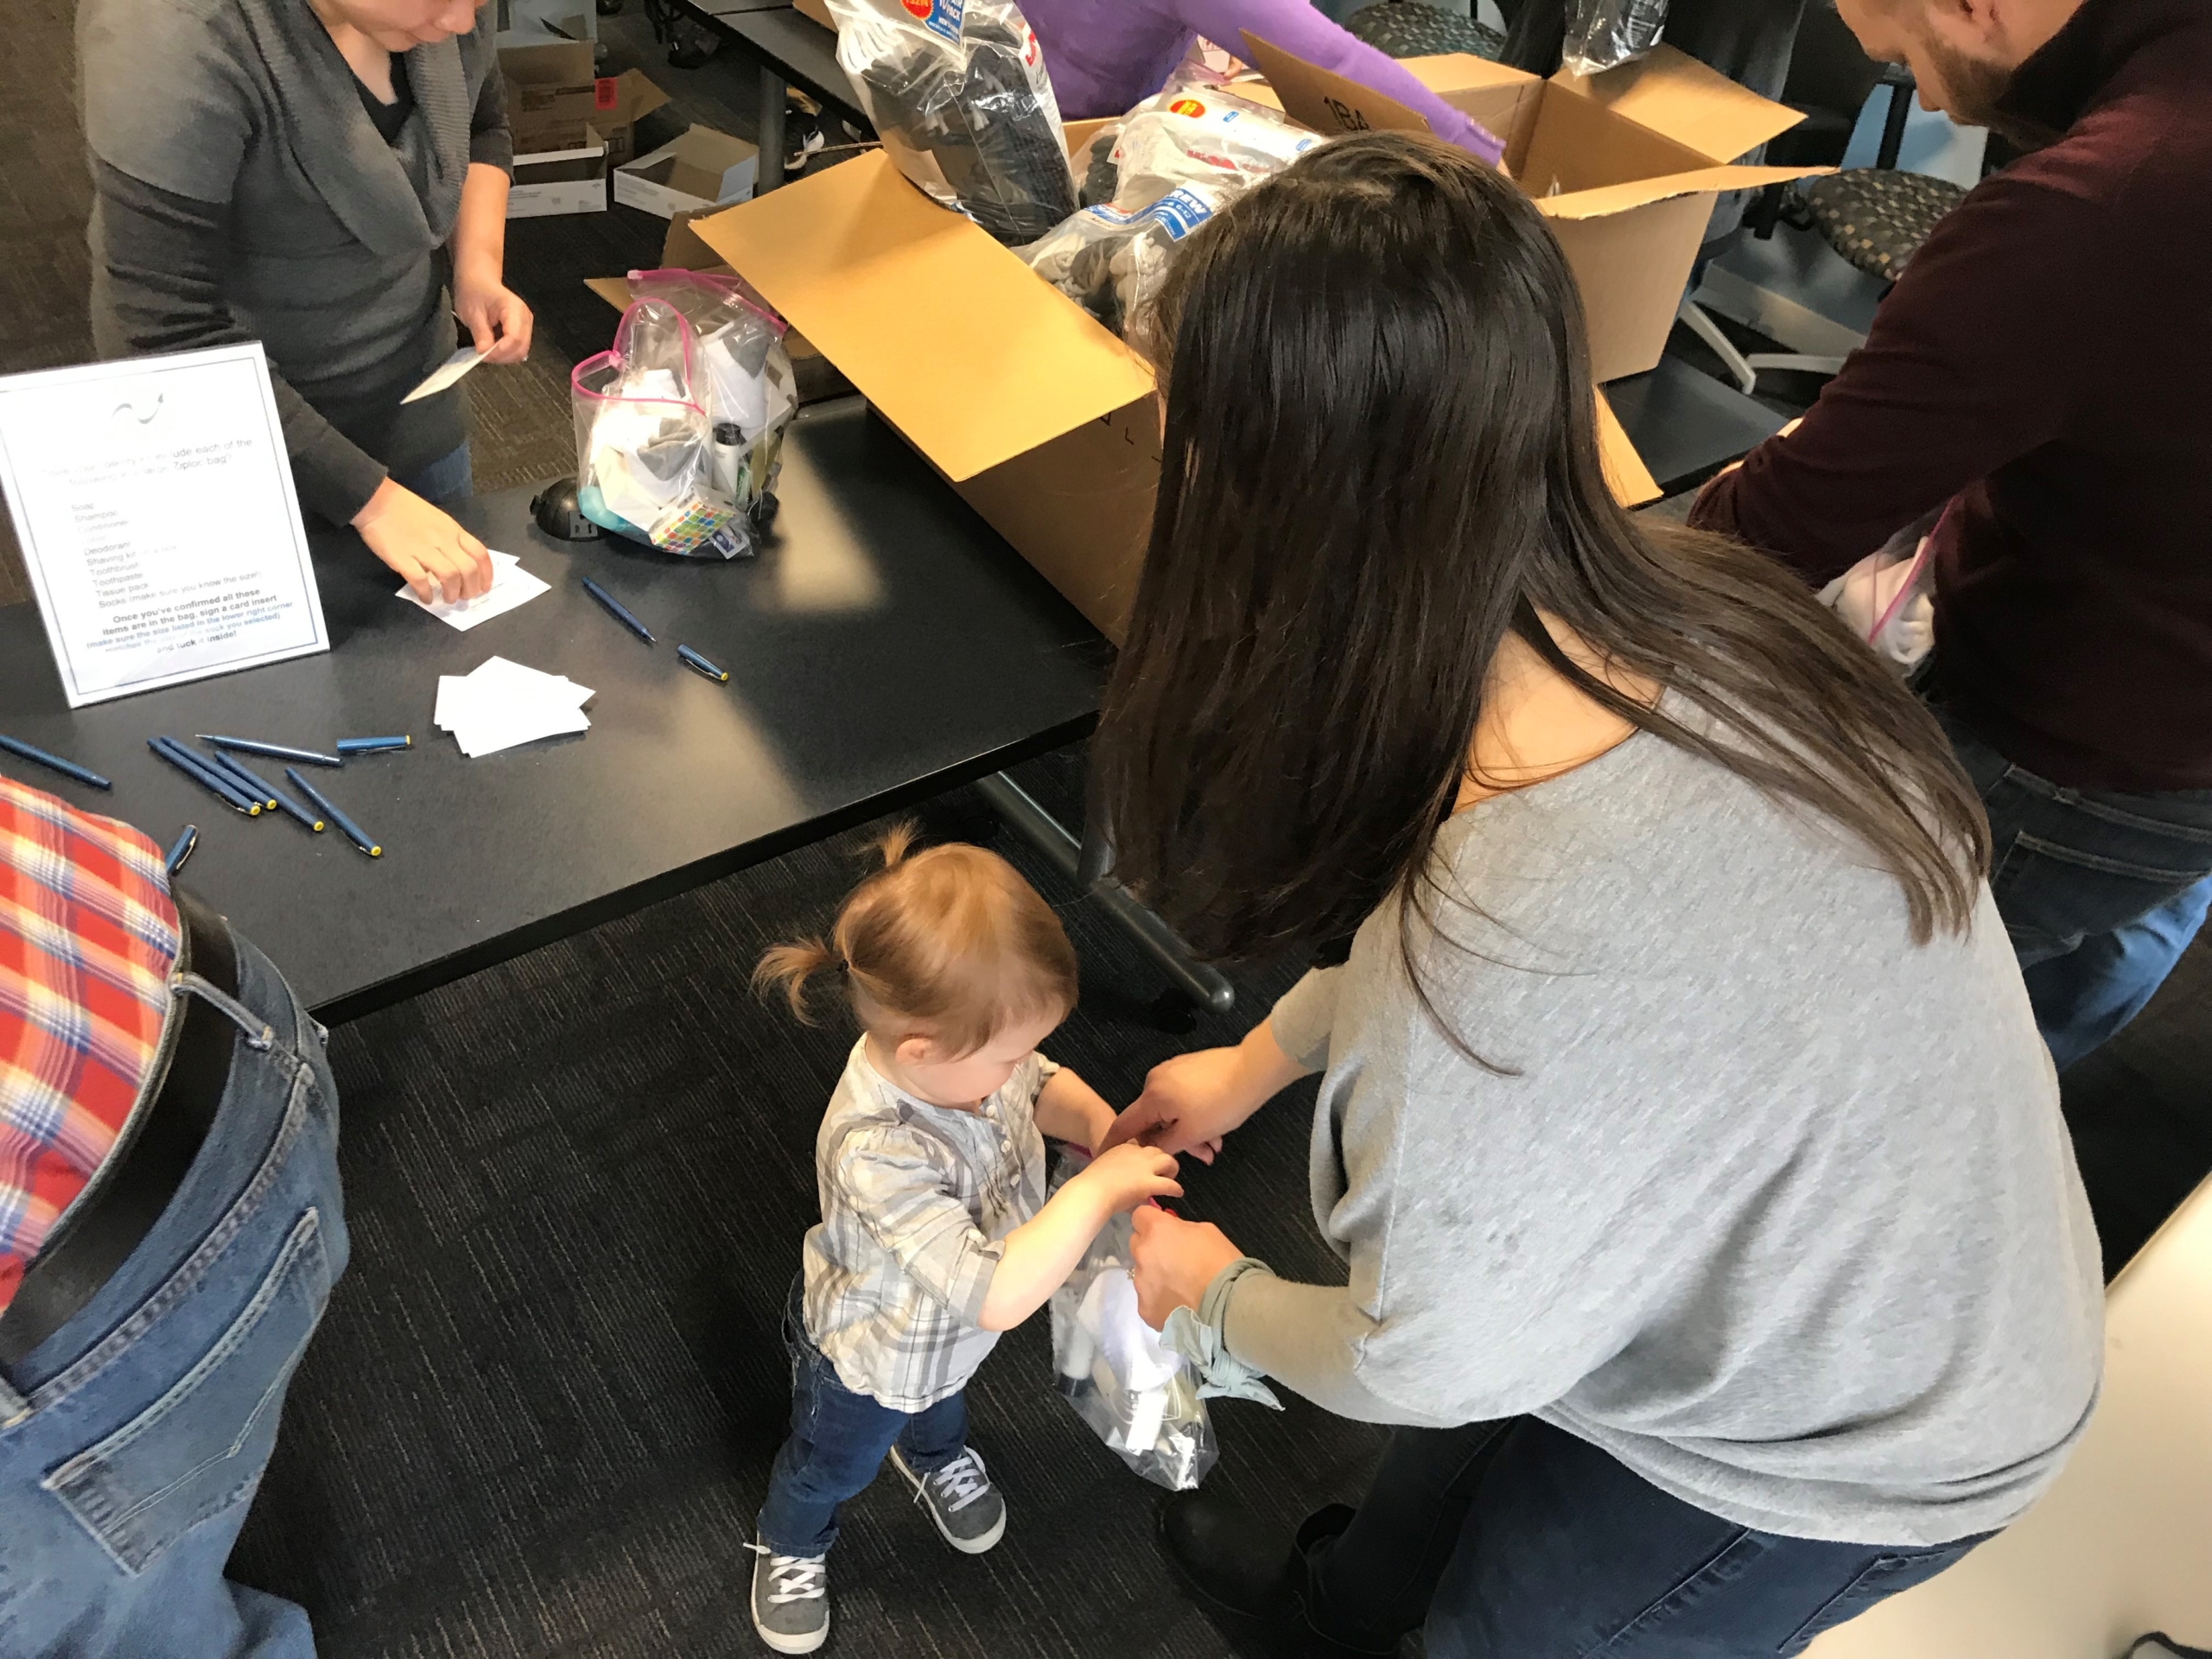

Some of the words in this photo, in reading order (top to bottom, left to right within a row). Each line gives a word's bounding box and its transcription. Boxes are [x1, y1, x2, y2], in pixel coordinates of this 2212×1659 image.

[1167, 189, 1207, 214] REW
[195, 443, 220, 454] each
[224, 441, 233, 449] of
[173, 461, 202, 471] Ziploc
[207, 454, 232, 465] bag?
[74, 511, 118, 522] Shampoo
[84, 542, 130, 556] Deodorant
[86, 555, 124, 566] Shaving
[89, 562, 138, 575] Toothbrush
[92, 573, 143, 587] Toothpaste
[96, 588, 125, 597] Tissue
[128, 582, 149, 593] pack
[99, 598, 127, 608] Socks
[130, 593, 156, 602] (make
[181, 585, 196, 594] you
[199, 580, 221, 588] know
[112, 613, 138, 623] Once
[140, 607, 172, 620] you've
[174, 595, 220, 612] confirmed
[235, 589, 260, 599] these
[102, 626, 130, 636] items
[200, 607, 219, 617] sign
[229, 600, 250, 611] card
[251, 594, 277, 606] insert
[205, 624, 225, 632] sock
[226, 621, 242, 631] you
[244, 612, 280, 626] selected)
[86, 639, 113, 649] (make
[115, 634, 136, 643] sure
[171, 620, 195, 632] listed
[221, 612, 245, 621] lower
[246, 607, 265, 617] right
[267, 602, 293, 612] corner
[157, 644, 175, 653] and
[176, 639, 197, 649] tuck
[207, 630, 237, 643] inside!
